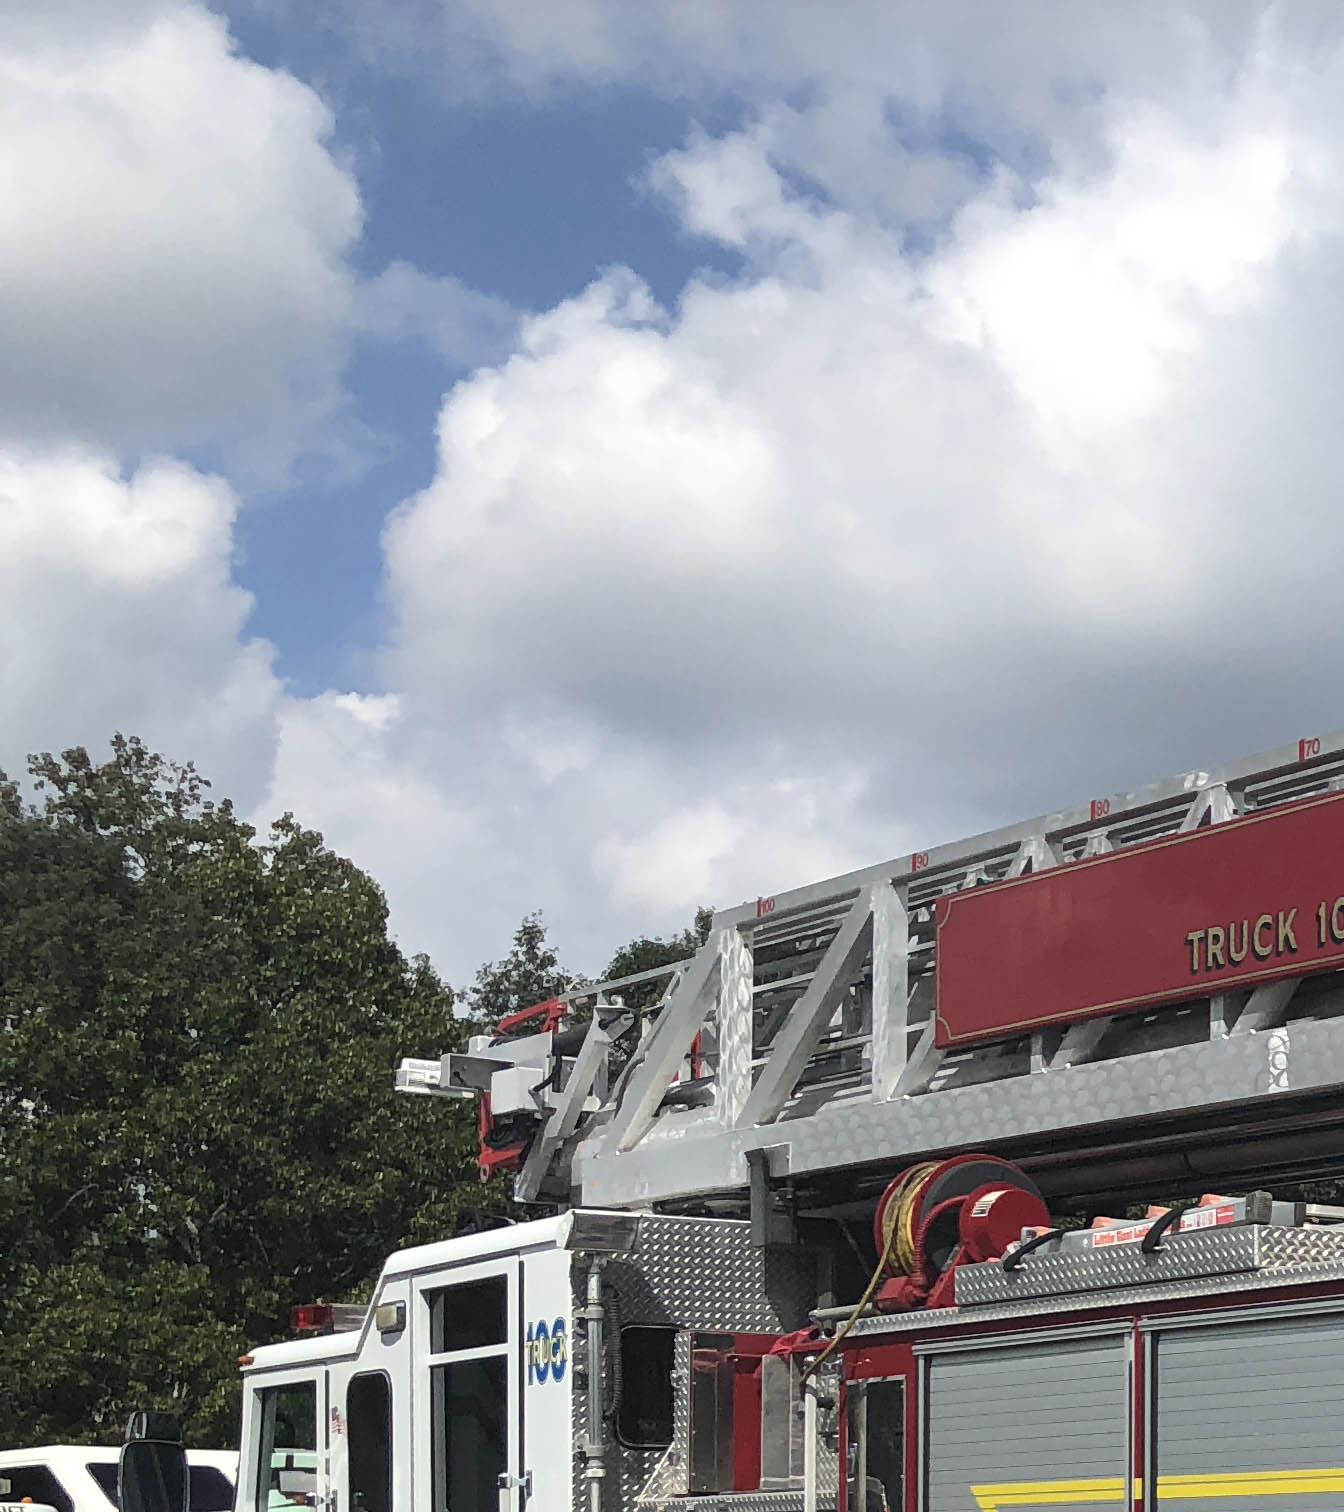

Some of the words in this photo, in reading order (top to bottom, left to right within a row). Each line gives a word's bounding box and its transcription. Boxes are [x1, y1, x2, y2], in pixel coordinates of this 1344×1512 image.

[1304, 737, 1321, 758] 70
[1096, 798, 1110, 817] 80
[916, 853, 929, 870] 90
[1186, 908, 1298, 971] TRUCK
[524, 1334, 568, 1365] TRUCK
